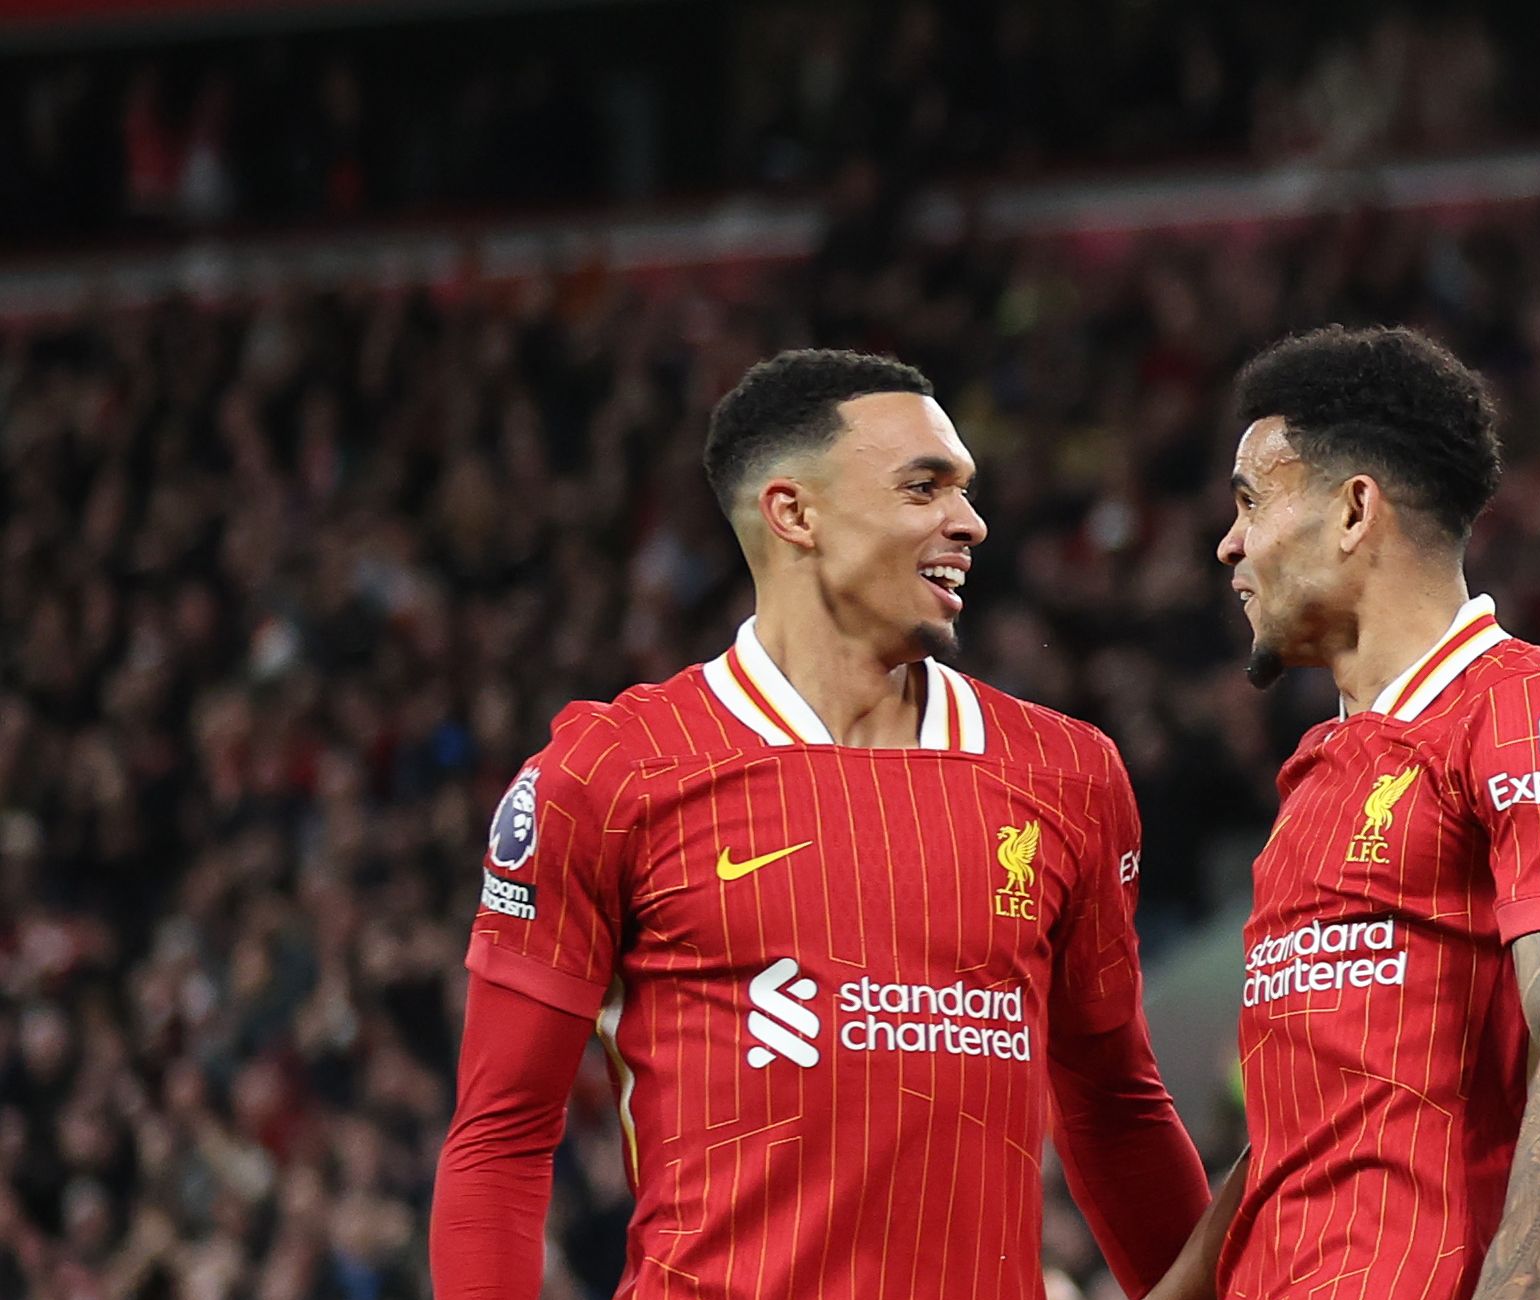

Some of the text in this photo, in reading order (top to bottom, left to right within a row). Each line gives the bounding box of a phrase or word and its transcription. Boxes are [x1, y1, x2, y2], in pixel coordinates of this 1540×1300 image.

[1245, 914, 1394, 970] standard
[839, 975, 1022, 1022] standard
[1243, 950, 1408, 1008] chartered
[840, 1014, 1031, 1062] chartered
